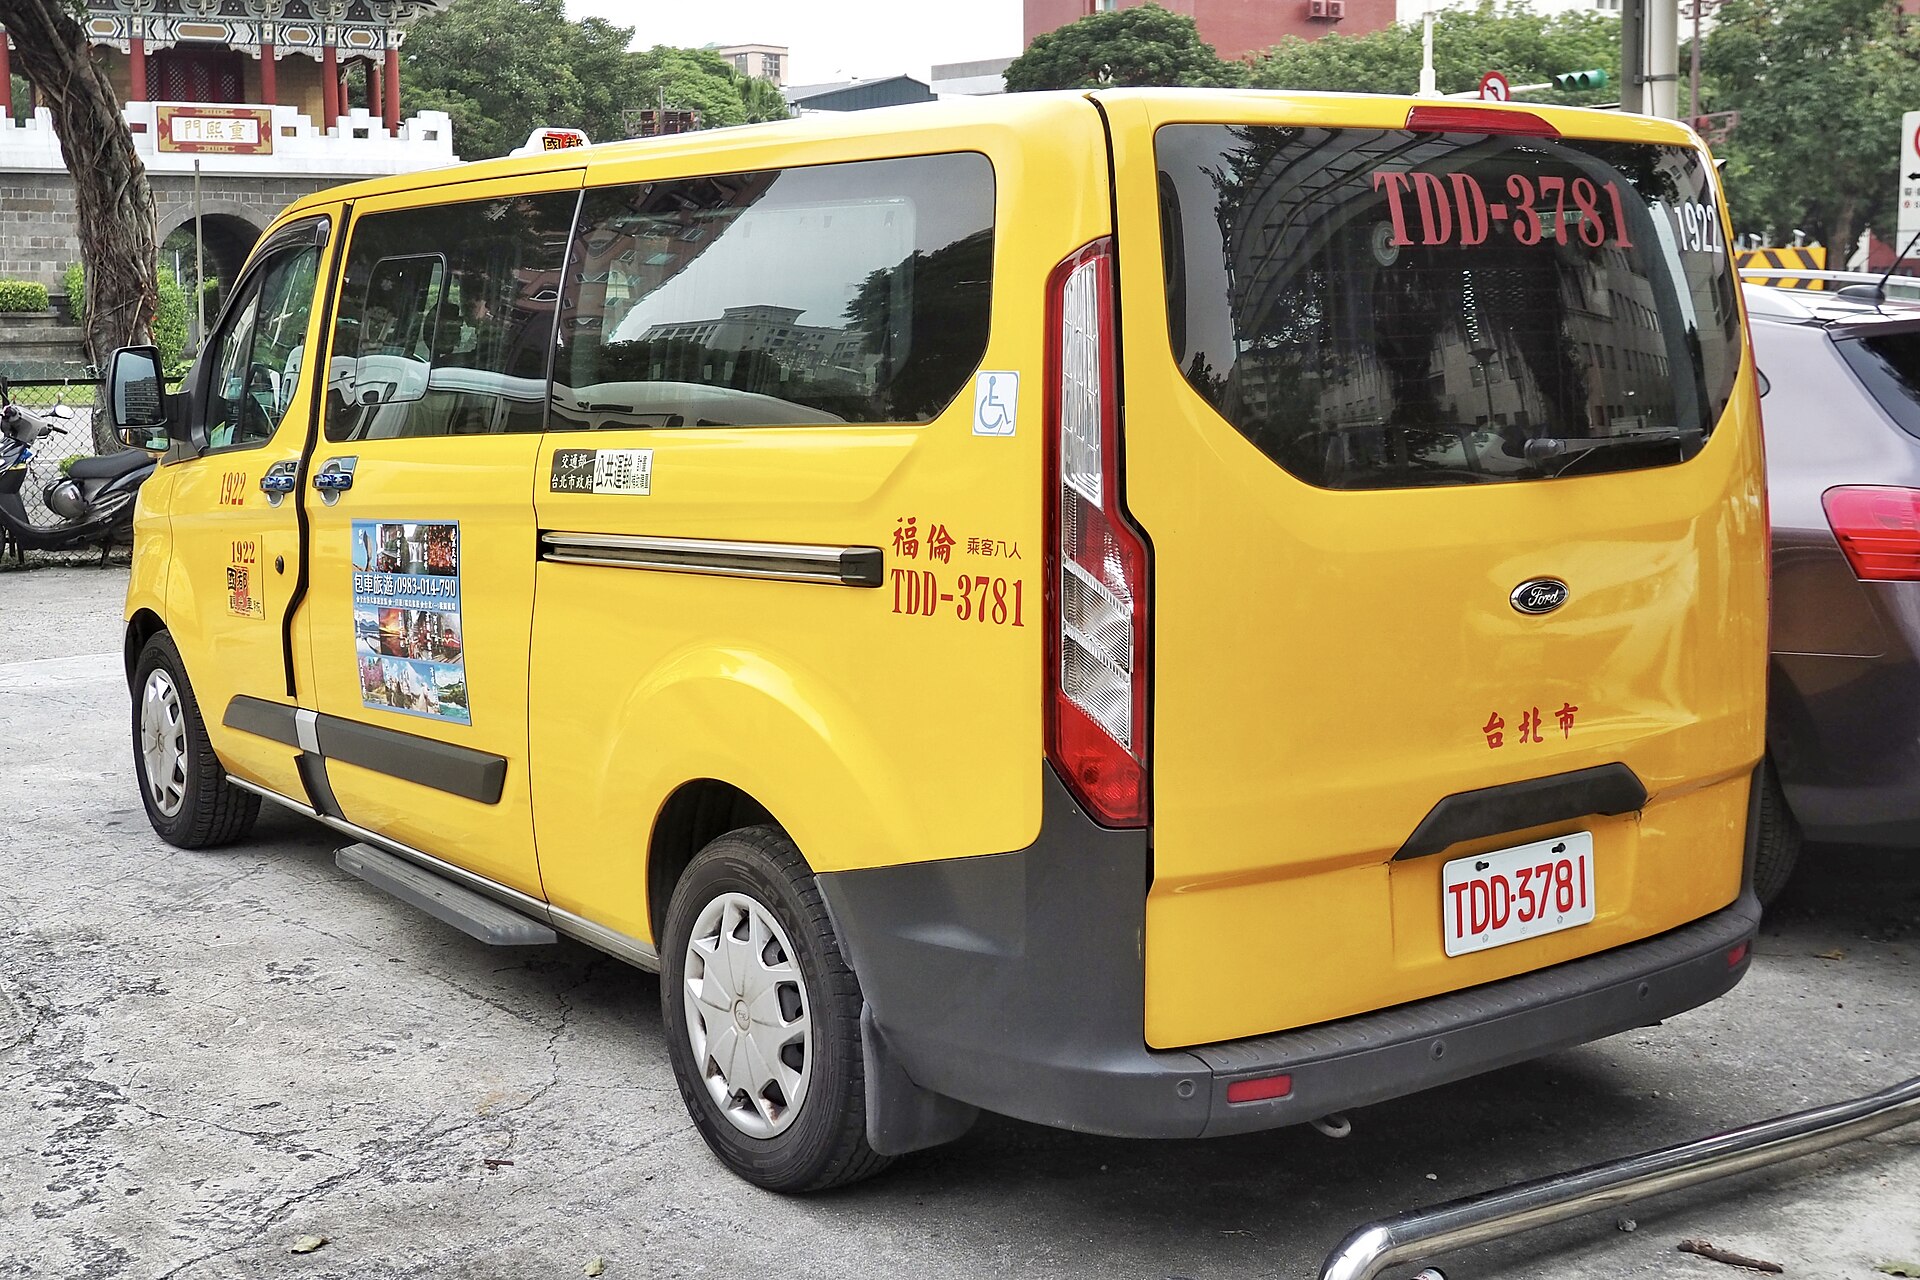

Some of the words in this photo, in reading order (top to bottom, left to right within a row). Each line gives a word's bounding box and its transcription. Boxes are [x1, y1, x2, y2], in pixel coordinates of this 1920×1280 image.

[1373, 172, 1633, 248] TDD-3781
[1674, 202, 1722, 254] 1922
[561, 454, 588, 469] 交通部
[595, 453, 633, 490] 公共運輸
[219, 472, 247, 505] 1922
[552, 474, 593, 490] 台北市政府
[231, 541, 255, 563] 1922
[892, 517, 957, 564] 福倫
[967, 537, 1022, 560] 乘客八人
[890, 568, 1025, 627] TDD-3781
[1528, 586, 1560, 607] Ford
[1483, 702, 1578, 749] 台北市
